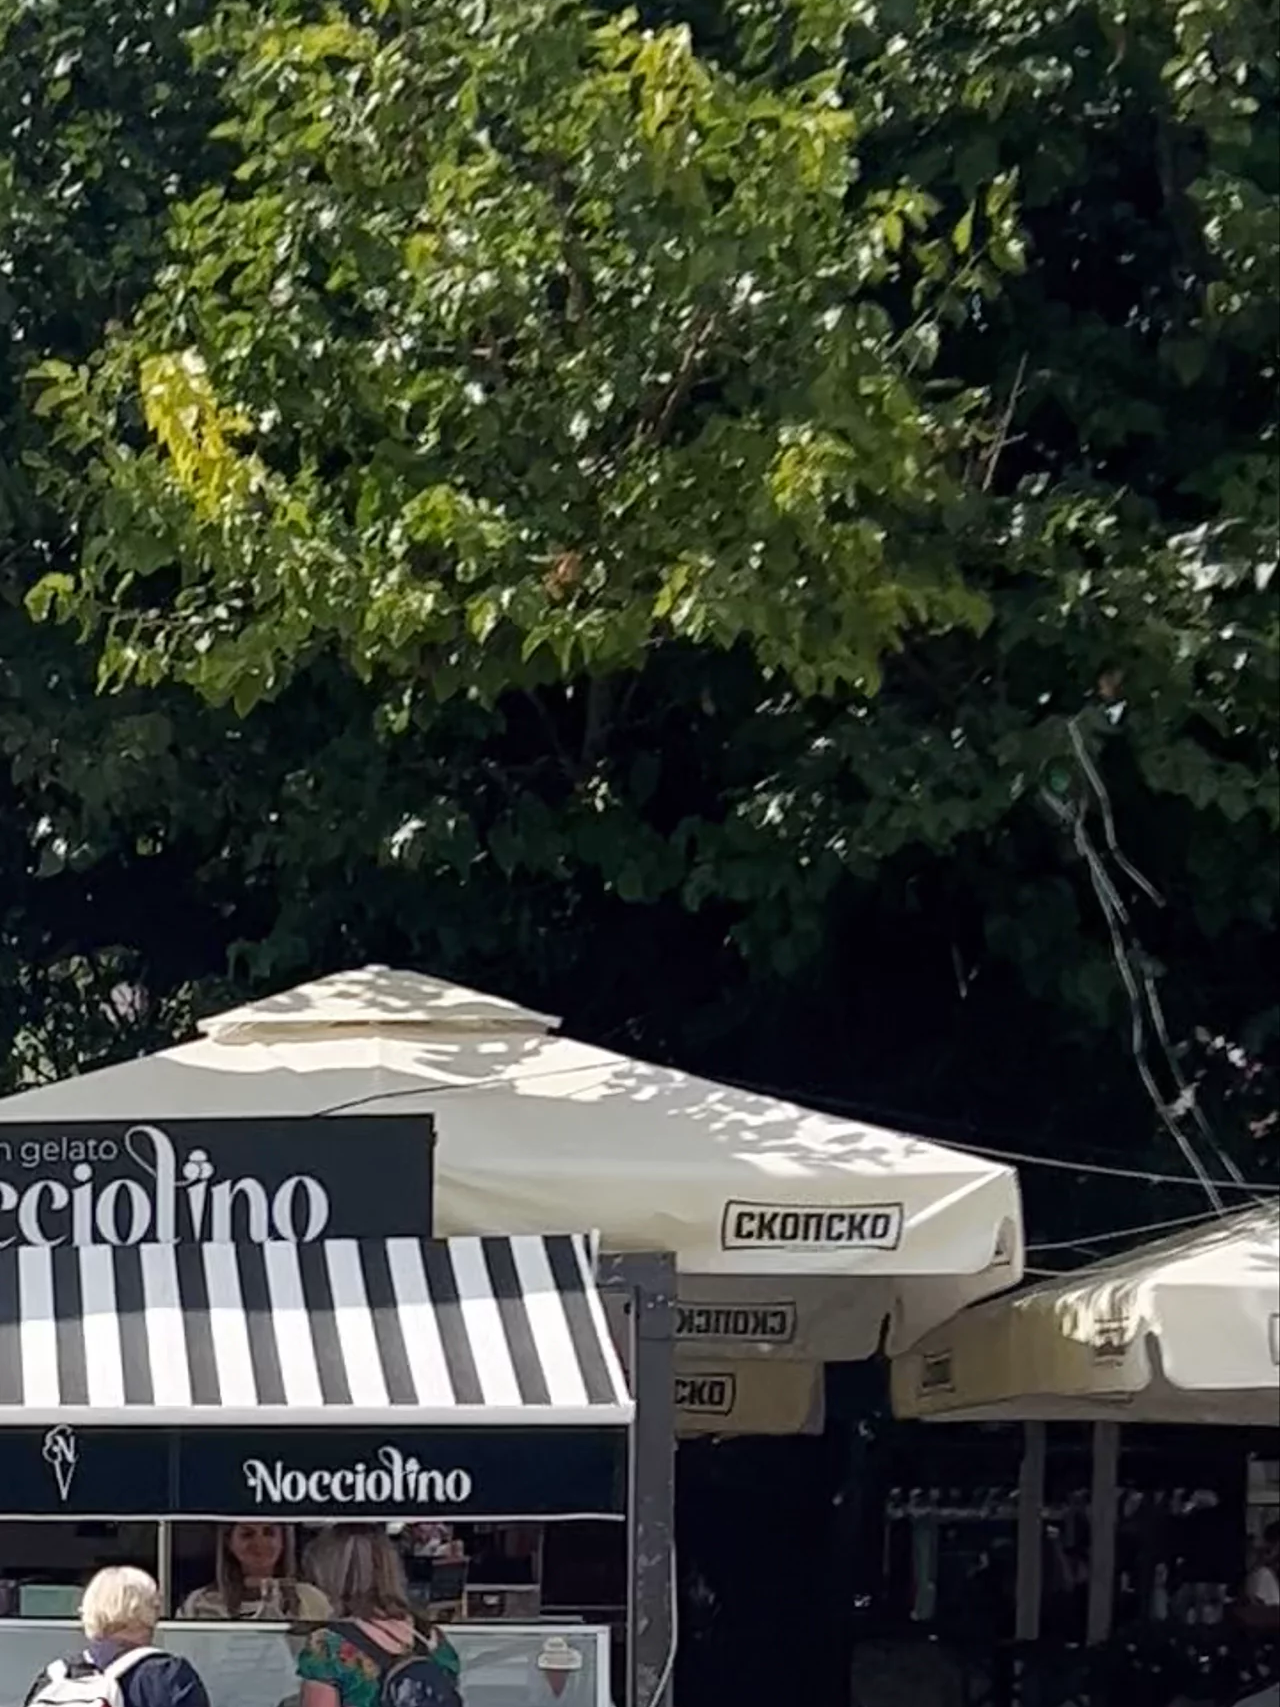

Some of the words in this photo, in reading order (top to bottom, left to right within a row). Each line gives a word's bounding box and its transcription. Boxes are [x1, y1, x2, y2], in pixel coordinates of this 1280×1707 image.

[20, 1136, 119, 1169] gelato
[734, 1211, 891, 1242] СКОПСКО
[242, 1445, 472, 1504] Nocciolino
